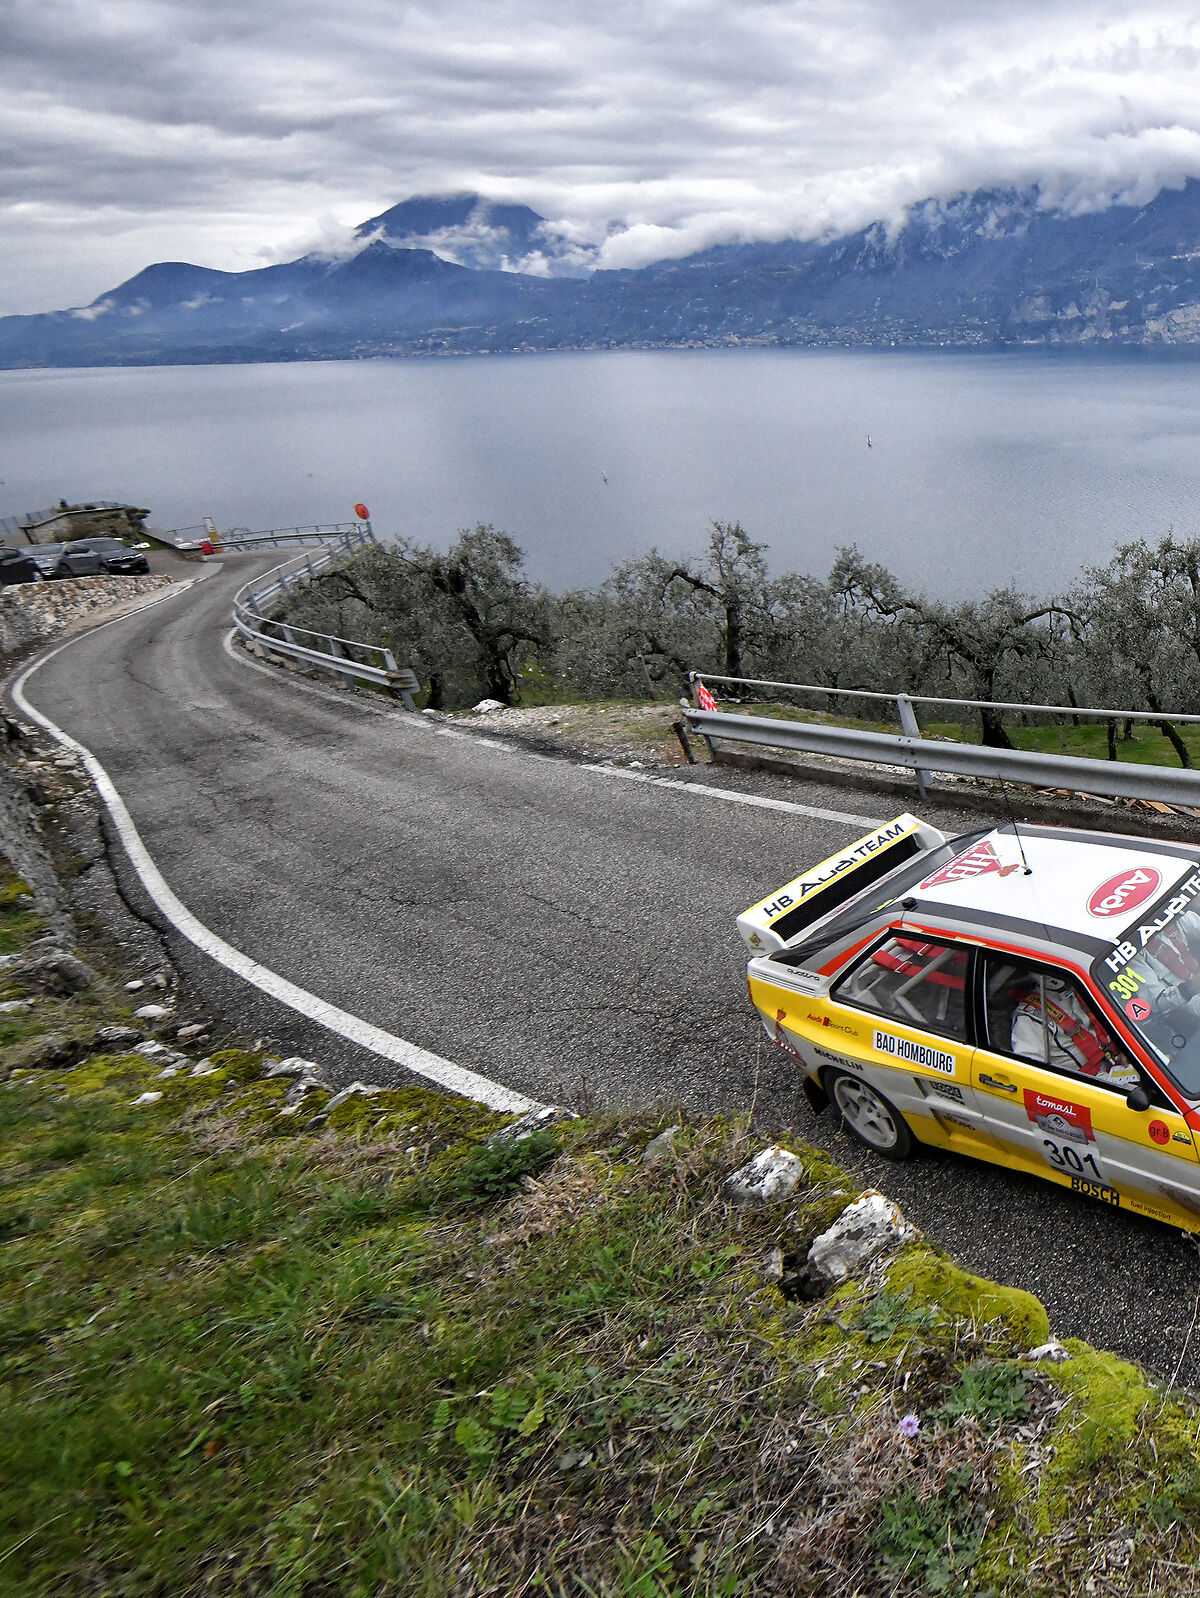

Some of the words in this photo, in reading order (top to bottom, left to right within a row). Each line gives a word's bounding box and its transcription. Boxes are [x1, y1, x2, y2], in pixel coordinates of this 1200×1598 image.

[764, 895, 794, 917] HB
[854, 824, 904, 857] TEAM
[1104, 941, 1137, 973] HB
[1108, 967, 1146, 1000] 301
[1131, 1002, 1148, 1018] A
[814, 1048, 864, 1071] MICHELIN
[876, 1032, 895, 1053] BAD
[897, 1039, 953, 1073] HOMBOURG
[1044, 1139, 1102, 1180] 301
[1071, 1176, 1120, 1206] BOSCH
[1130, 1200, 1144, 1209] fuel
[1144, 1204, 1171, 1220] injection
